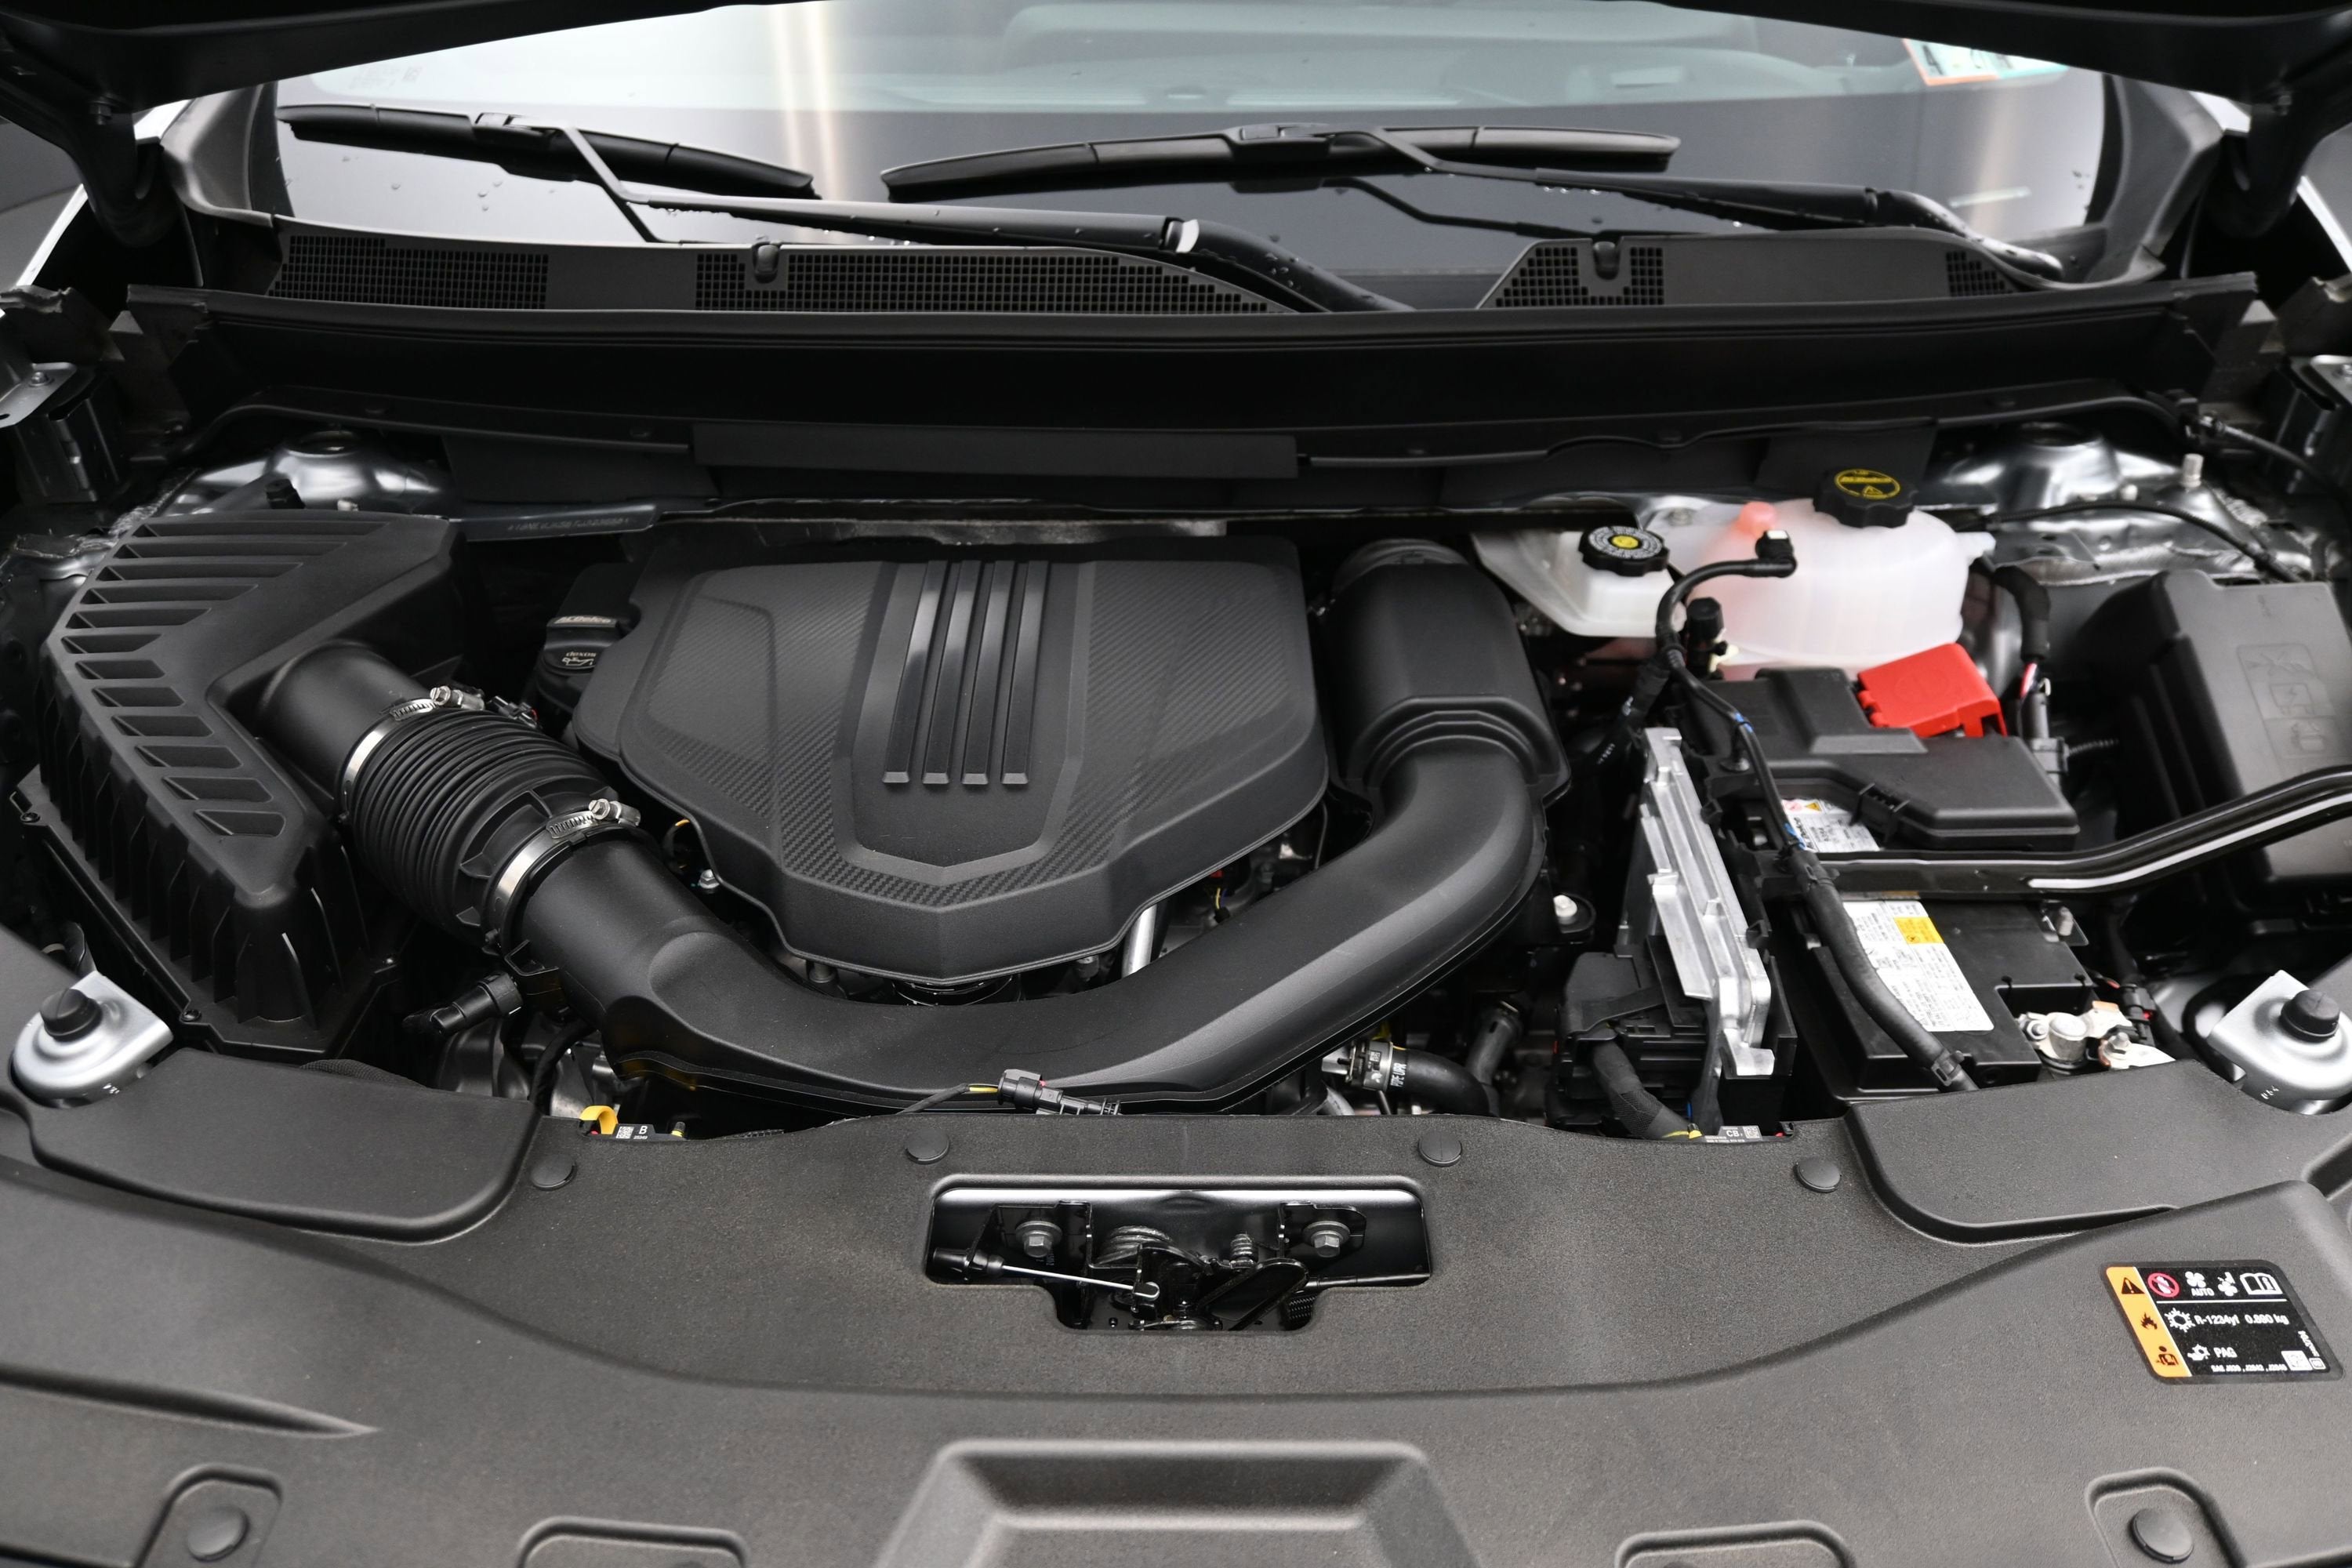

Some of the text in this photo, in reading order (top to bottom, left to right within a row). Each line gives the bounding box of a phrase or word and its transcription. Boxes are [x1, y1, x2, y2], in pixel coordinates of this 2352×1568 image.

[638, 1125, 648, 1134] B
[2191, 1287, 2215, 1296] AUTO
[2273, 1314, 2289, 1325] kg
[2213, 1347, 2238, 1358] PAG
